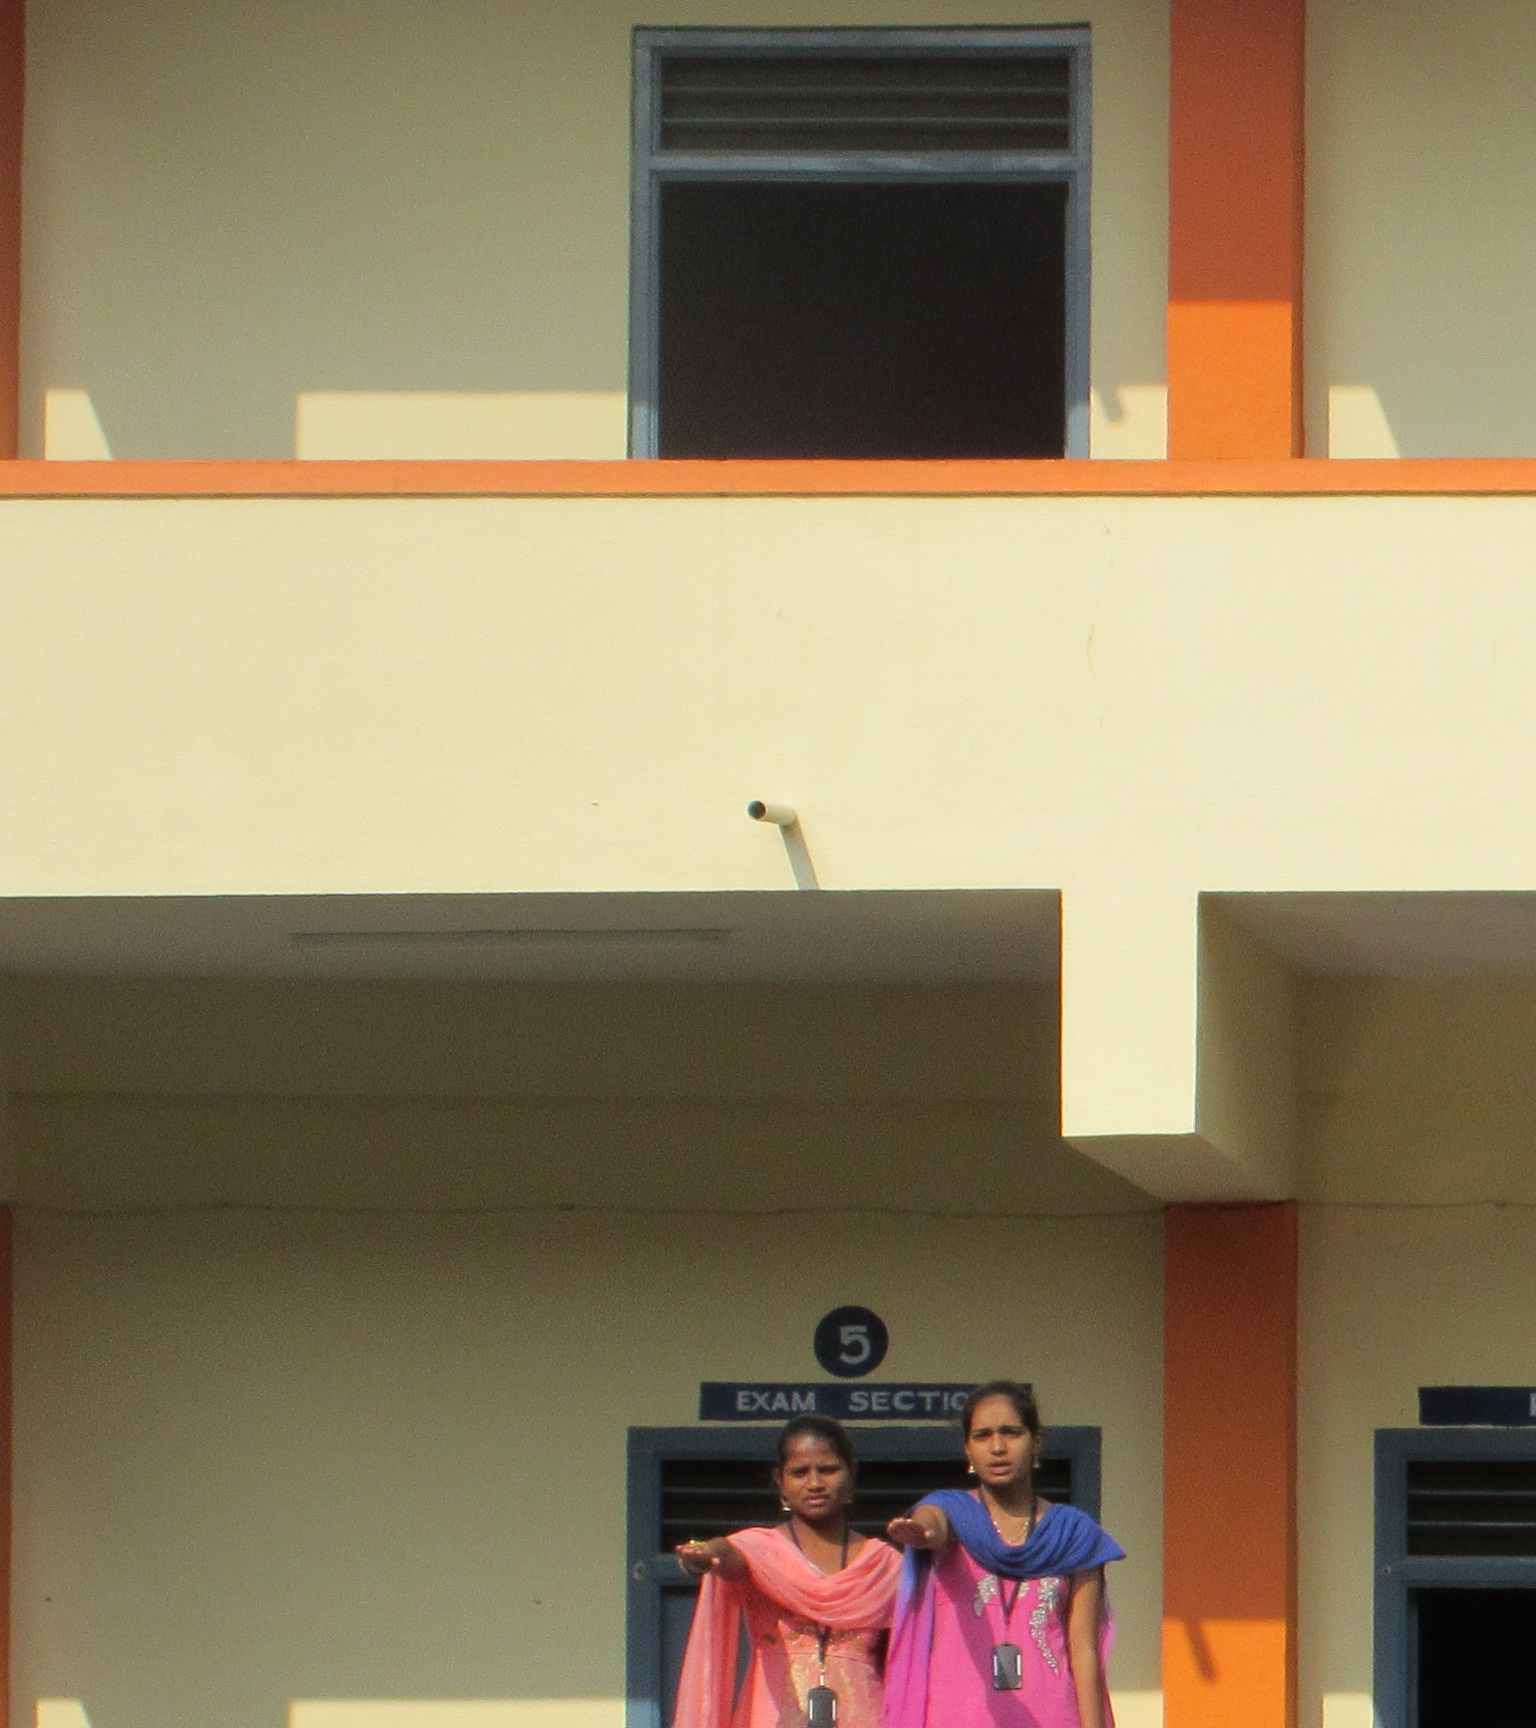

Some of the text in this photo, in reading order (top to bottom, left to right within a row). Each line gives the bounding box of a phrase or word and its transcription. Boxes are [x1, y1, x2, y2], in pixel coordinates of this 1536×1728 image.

[838, 1324, 872, 1365] 5
[736, 1391, 969, 1413] EXAM SECTIO
